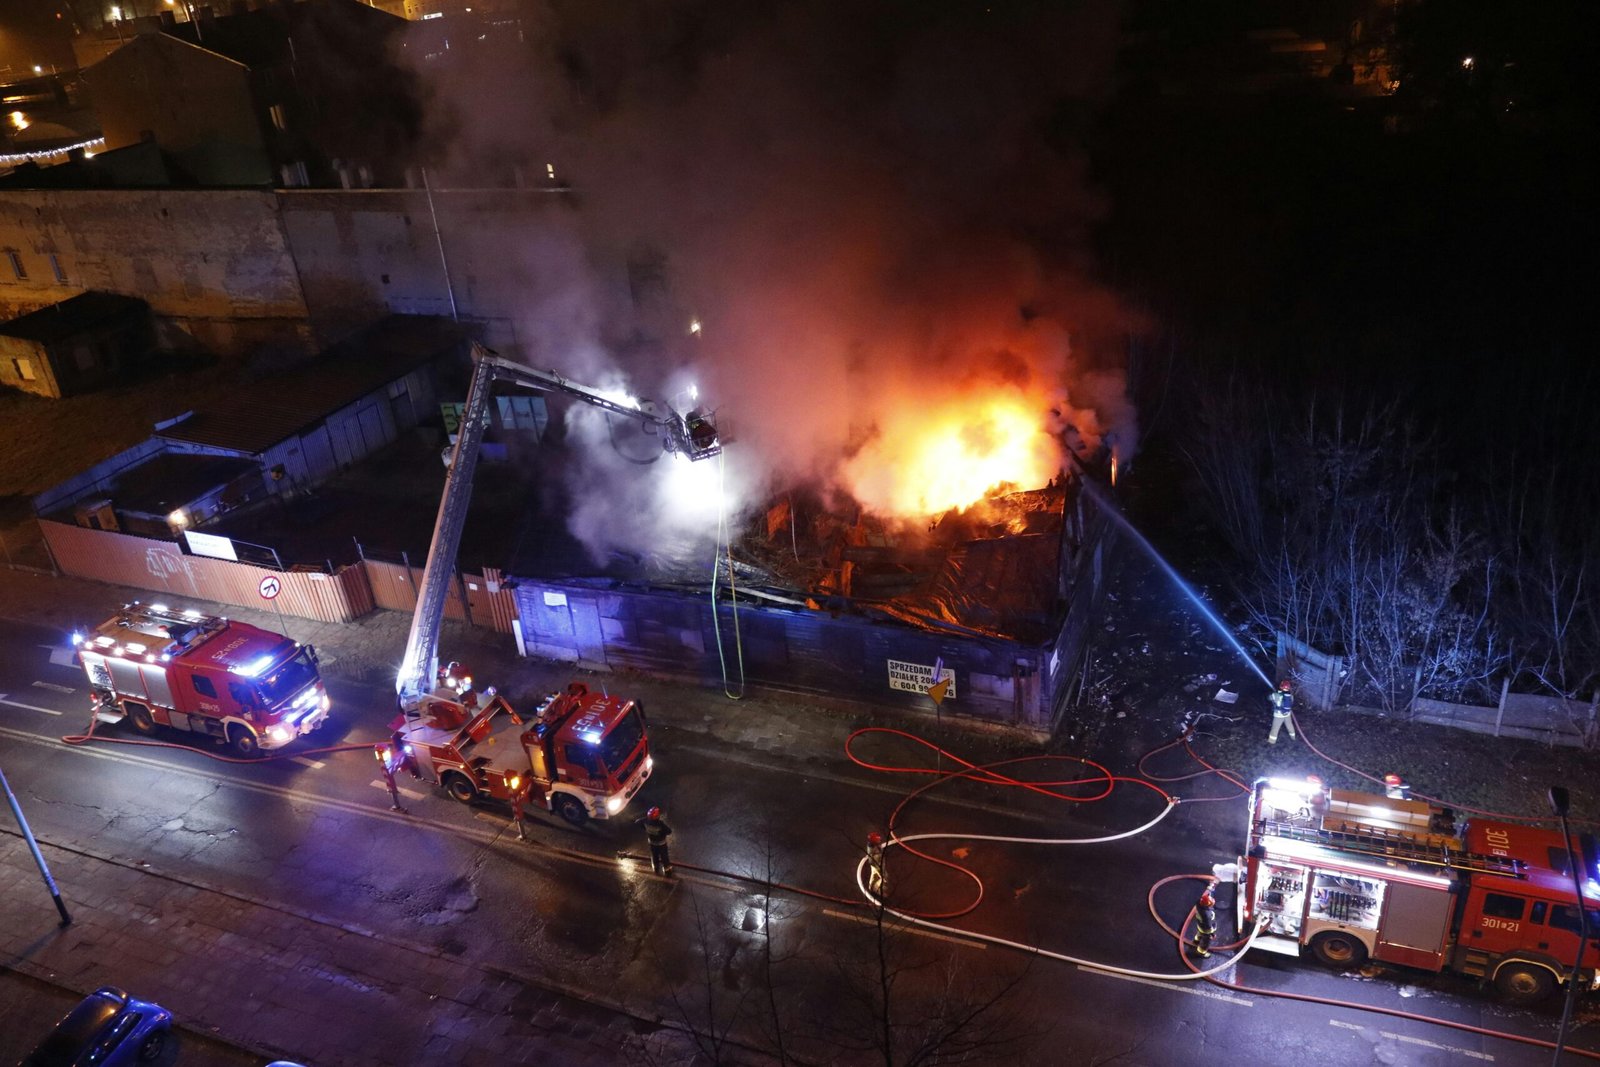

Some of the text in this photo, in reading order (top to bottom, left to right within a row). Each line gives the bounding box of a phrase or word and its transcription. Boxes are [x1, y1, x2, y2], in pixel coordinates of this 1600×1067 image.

[889, 661, 932, 676] SPRZEDAM
[890, 671, 919, 685] DZIAŁKĘ
[900, 682, 916, 691] 604
